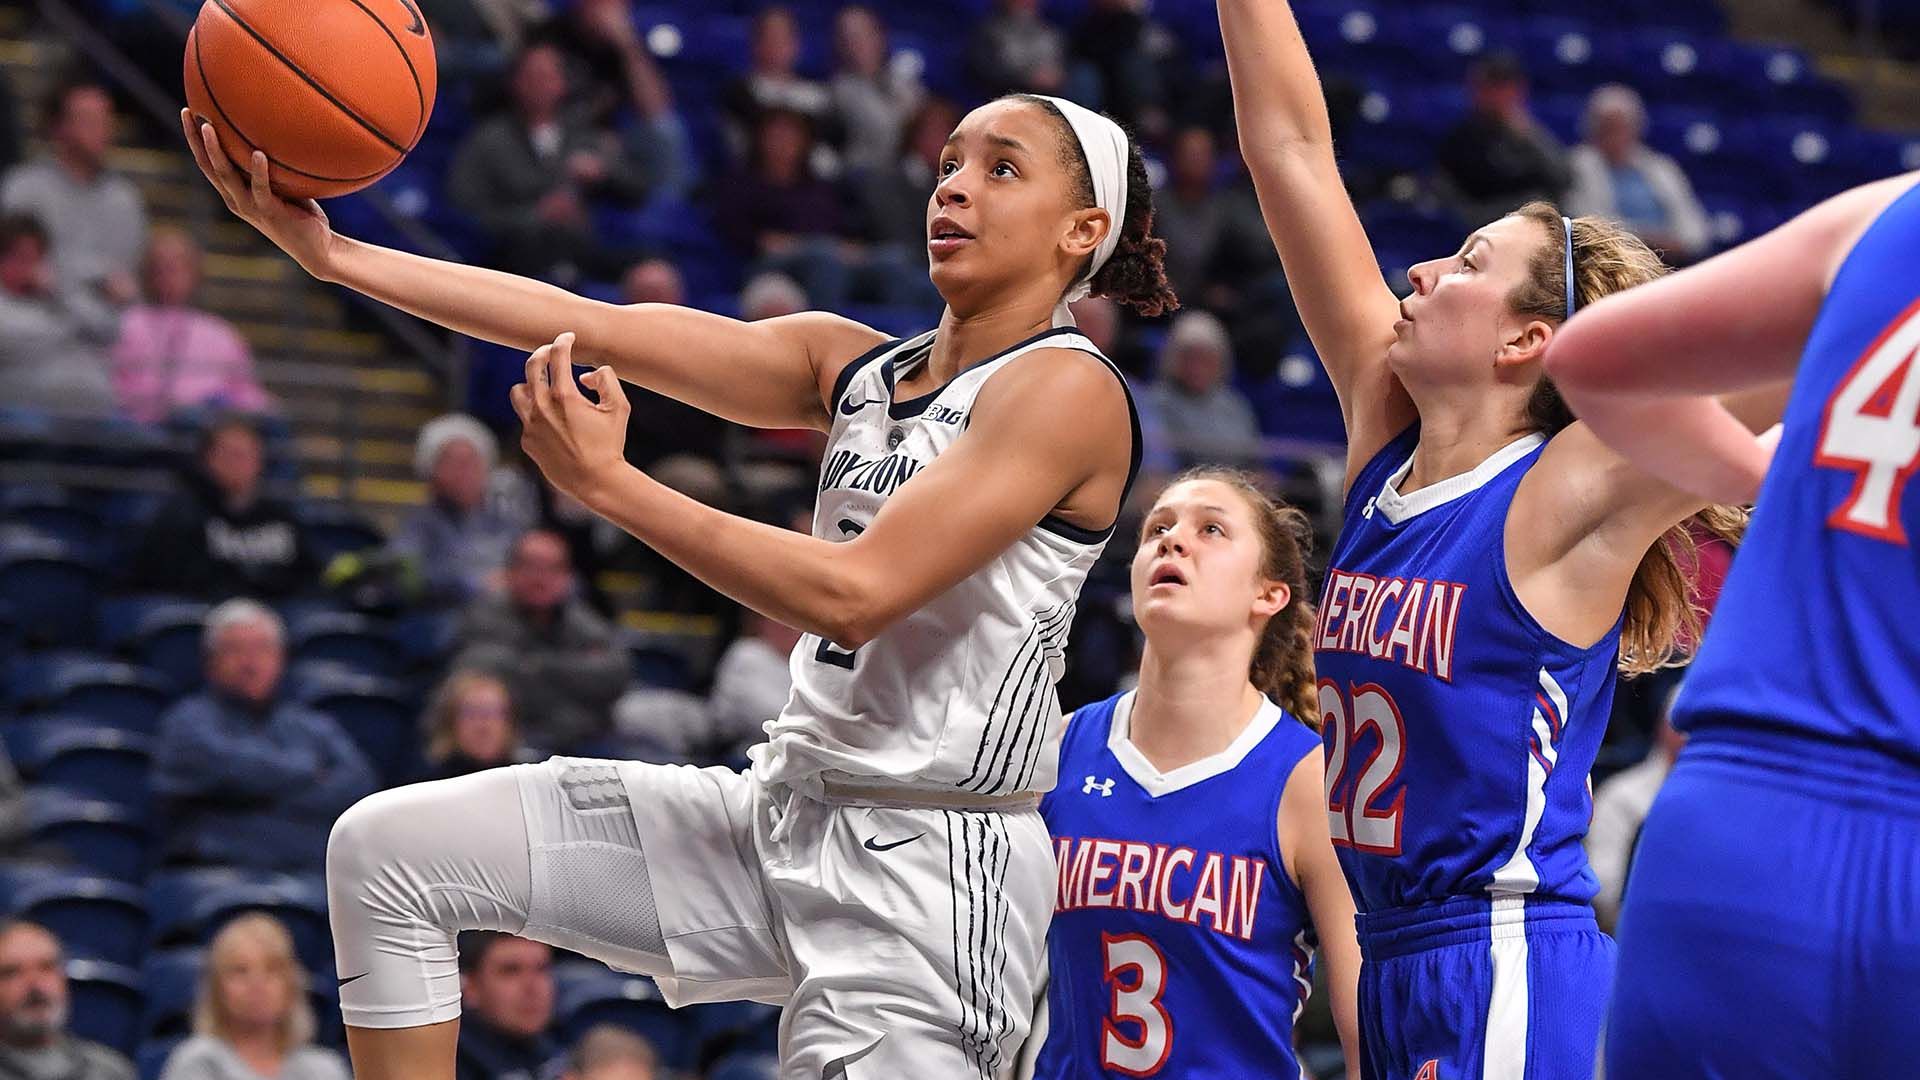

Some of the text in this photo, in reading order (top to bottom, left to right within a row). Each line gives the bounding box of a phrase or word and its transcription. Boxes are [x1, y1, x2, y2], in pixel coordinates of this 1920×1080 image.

[1813, 297, 1920, 546] 4
[1317, 677, 1407, 857] 22
[1052, 837, 1265, 940] MERICAN
[1102, 930, 1174, 1078] 3
